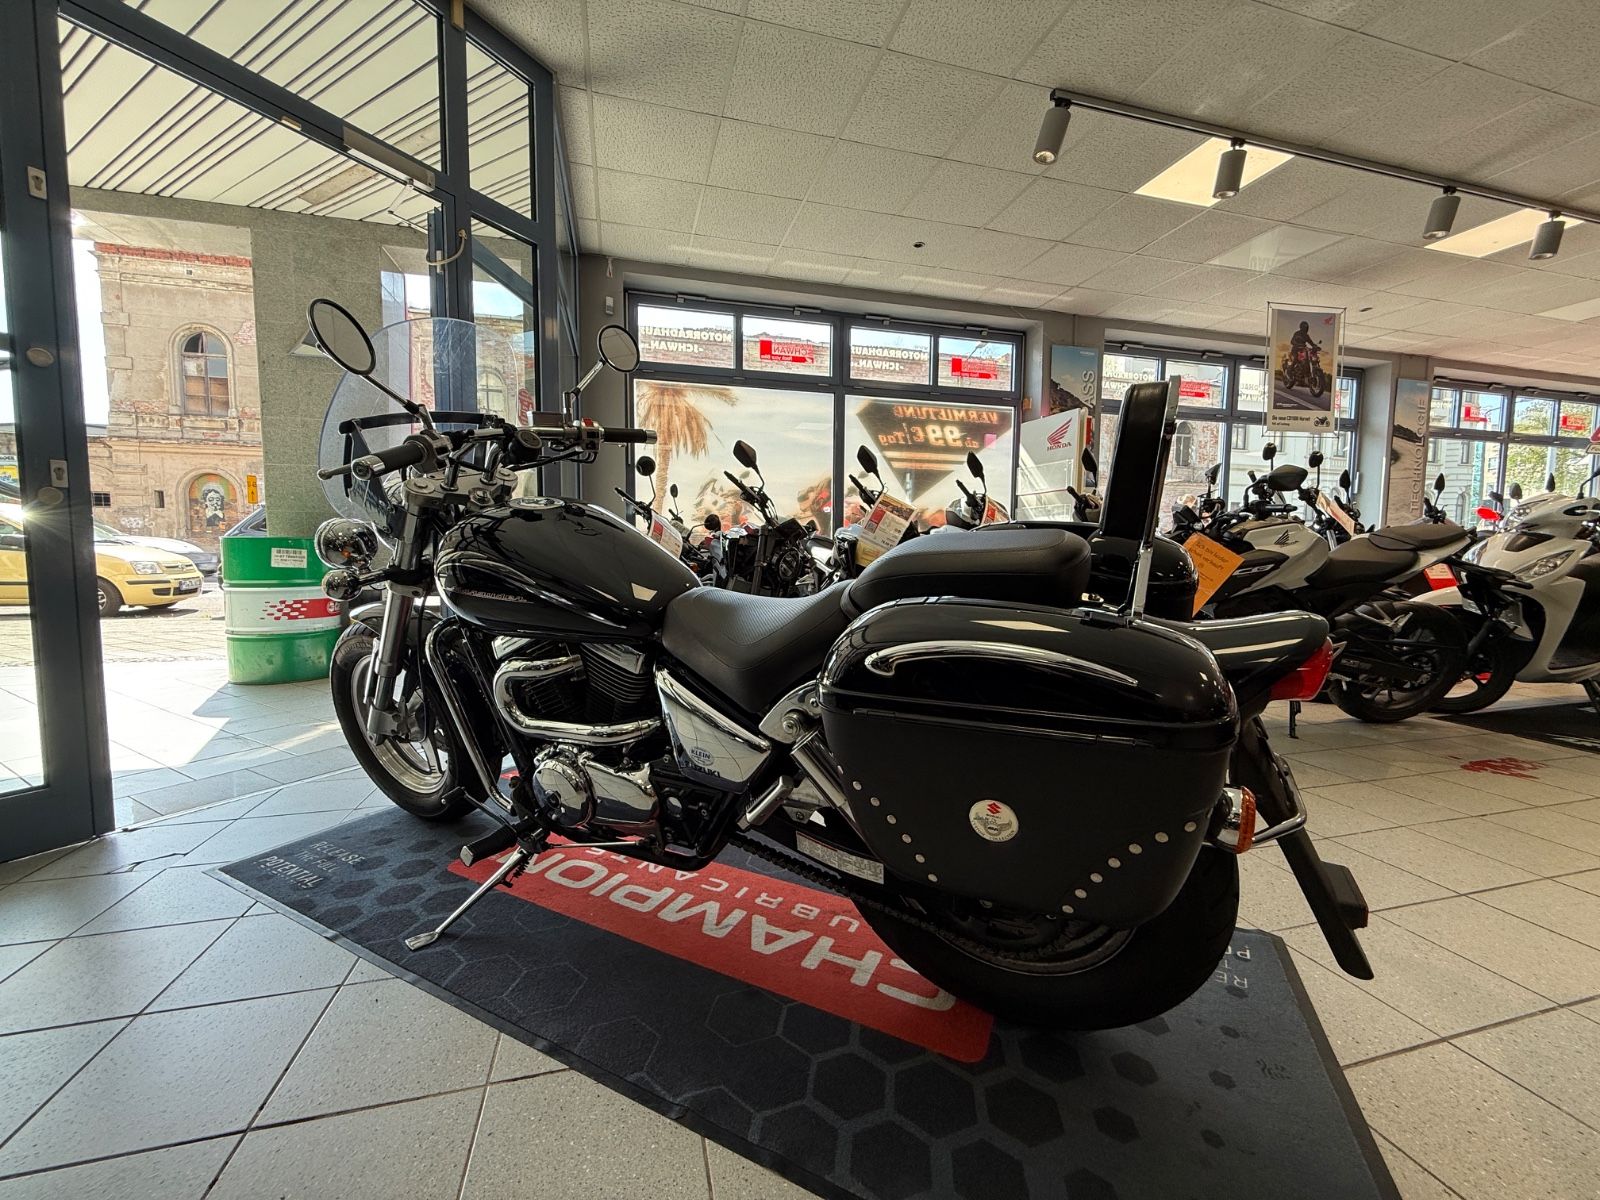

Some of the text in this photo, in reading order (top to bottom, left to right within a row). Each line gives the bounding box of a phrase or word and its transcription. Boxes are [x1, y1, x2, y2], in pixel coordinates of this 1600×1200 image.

[1081, 370, 1095, 409] ASS
[1047, 441, 1072, 451] HONDA
[1410, 398, 1427, 513] TECHNOLOGIE
[691, 749, 711, 759] KLEIN
[295, 849, 341, 873] THE FULL
[310, 840, 366, 866] RELEASE
[257, 855, 325, 889] POTENTIAL
